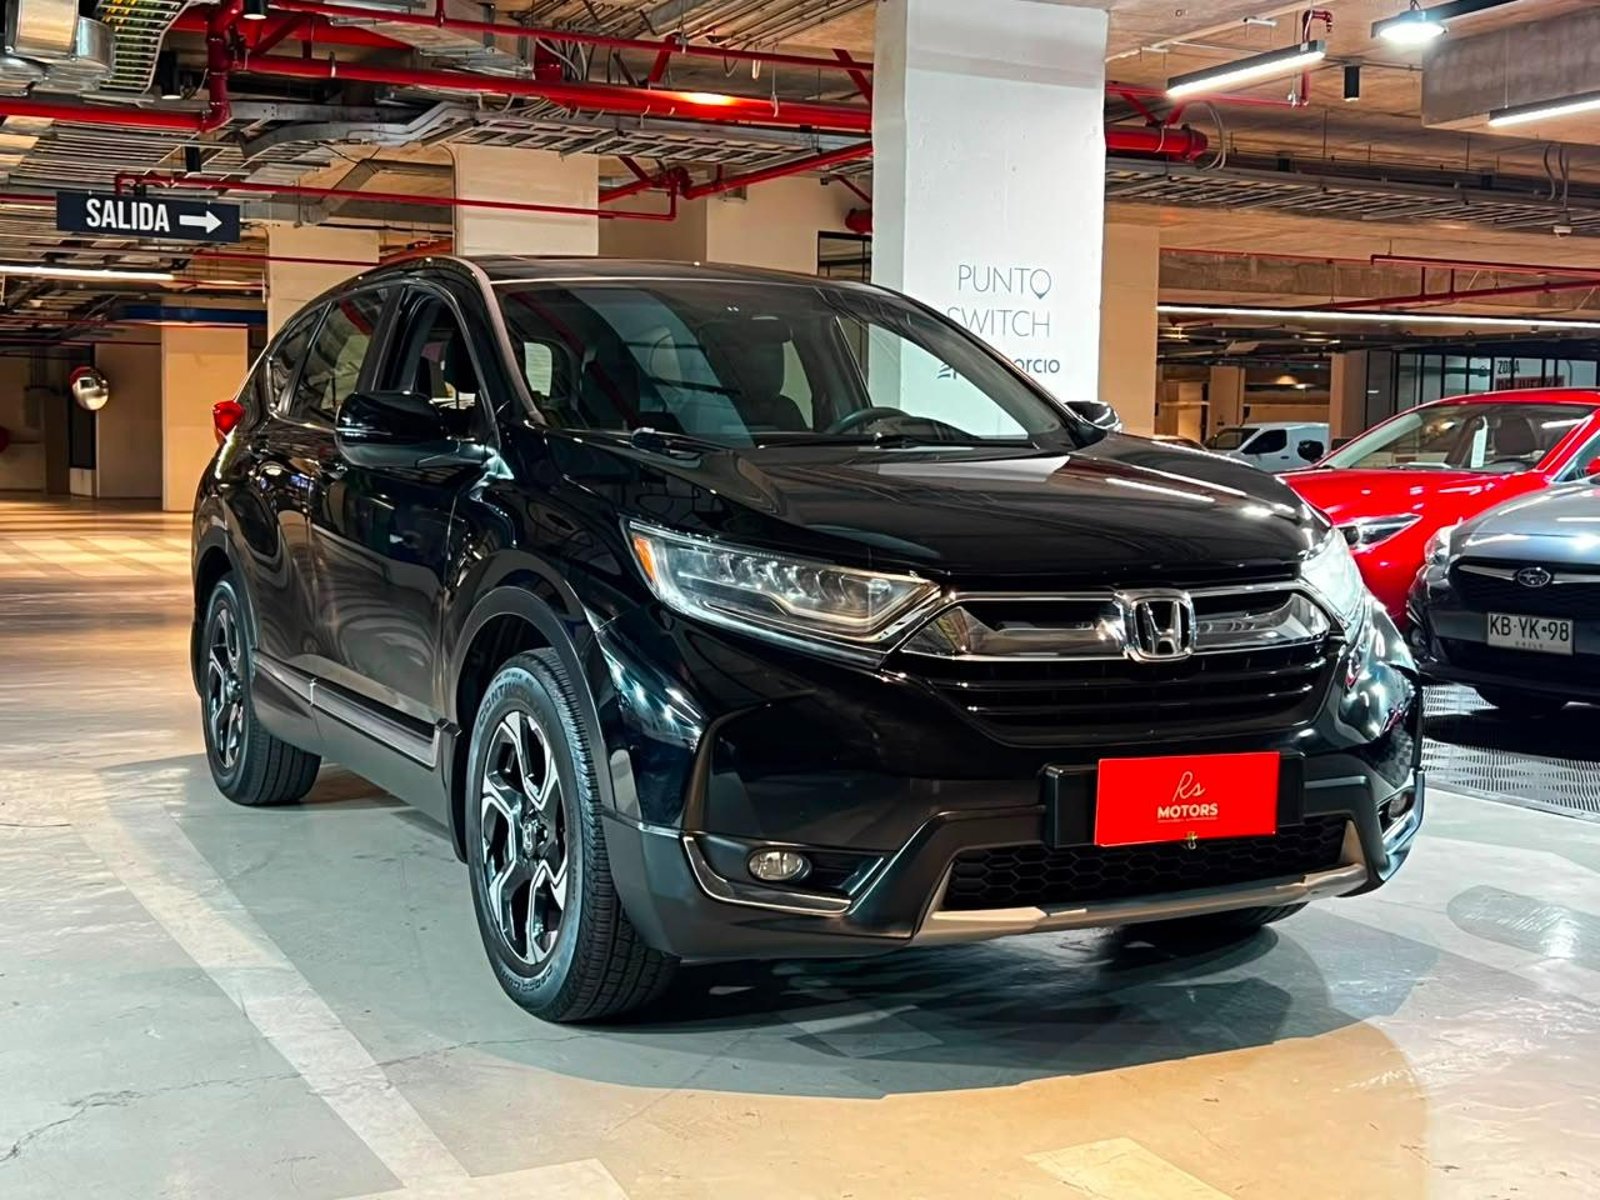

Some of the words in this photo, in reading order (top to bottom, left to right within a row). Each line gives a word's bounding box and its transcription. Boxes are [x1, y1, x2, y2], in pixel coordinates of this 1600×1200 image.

[86, 199, 170, 232] SALIDA
[958, 264, 1052, 299] PUNTO
[1172, 770, 1206, 802] Rs
[1157, 803, 1218, 819] MOTORS
